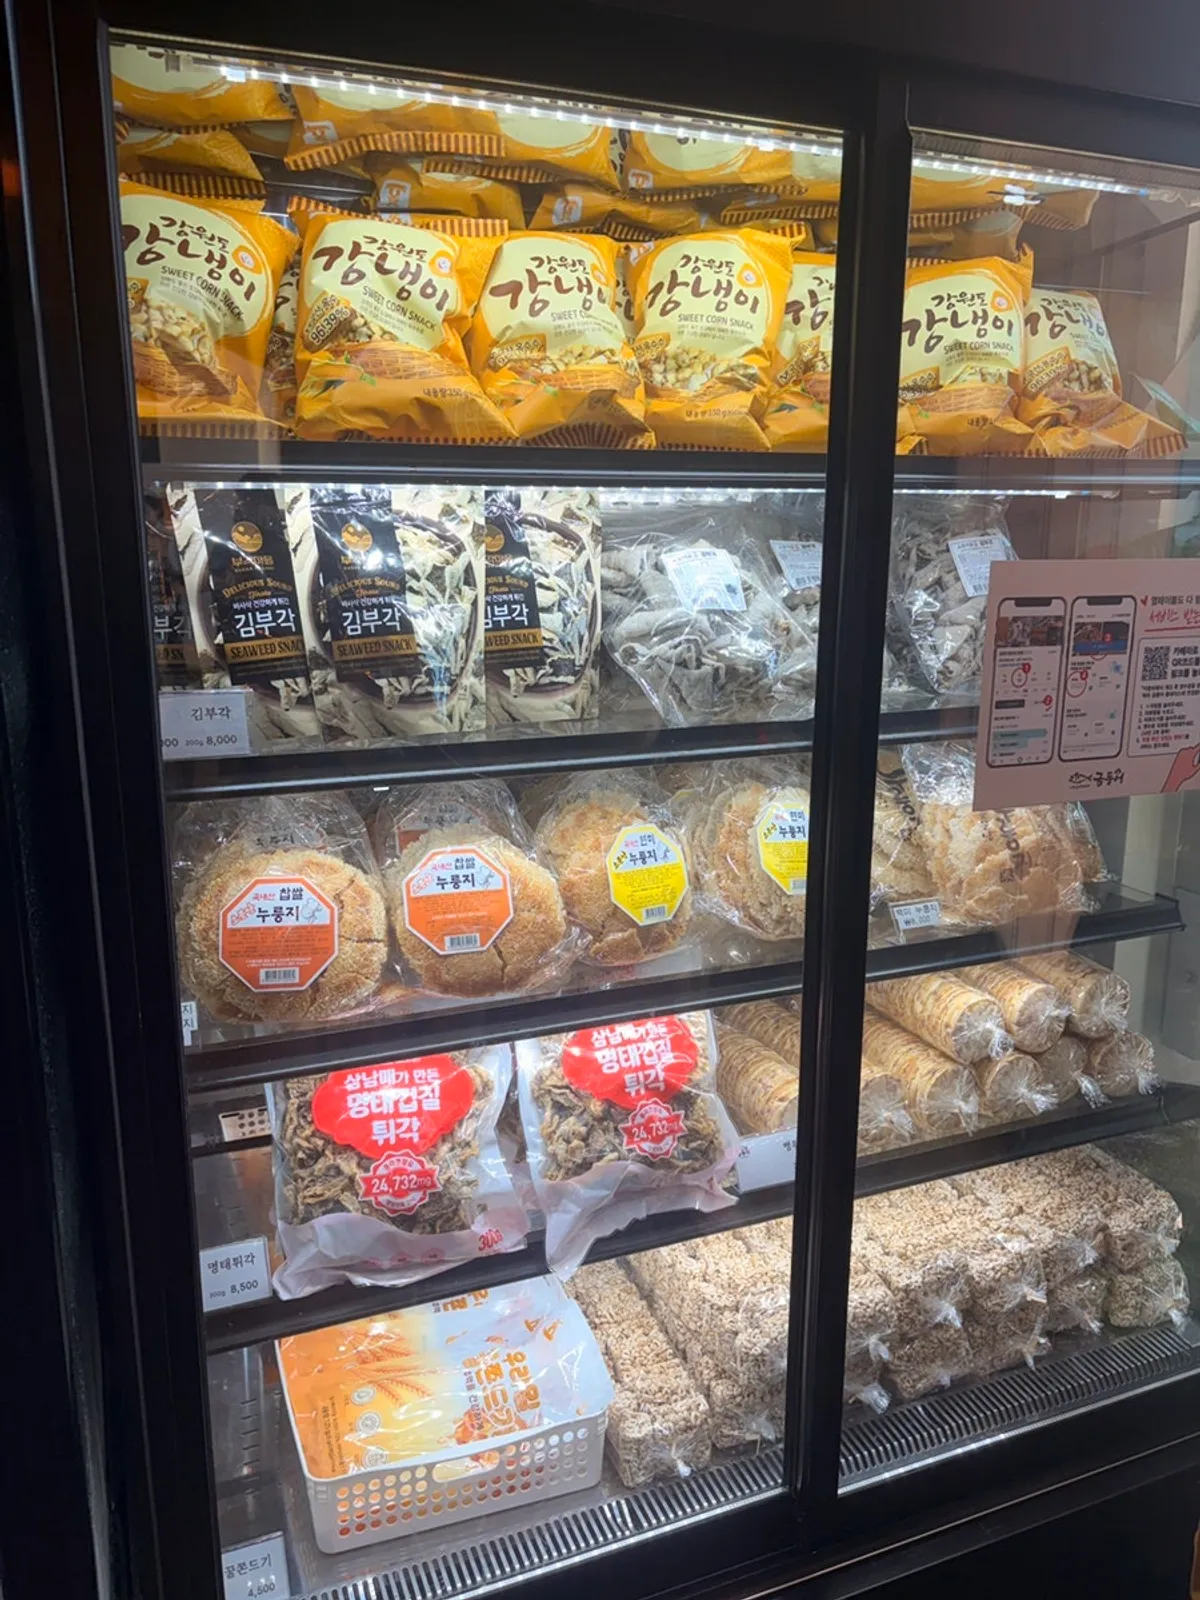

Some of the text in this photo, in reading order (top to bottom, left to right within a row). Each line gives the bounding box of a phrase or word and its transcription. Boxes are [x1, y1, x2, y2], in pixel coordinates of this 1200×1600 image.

[679, 254, 735, 277] 강원도
[160, 265, 195, 282] SWEET
[195, 275, 220, 298] CORN
[312, 239, 450, 312] 강냉이
[645, 269, 760, 318] 강냉이
[931, 291, 988, 310] 강원도
[362, 285, 386, 307] SWEET
[386, 299, 408, 318] CORN
[408, 310, 437, 332] SNACK
[550, 309, 578, 322] SWEET
[677, 313, 755, 331] SWEET CORN SNACK
[900, 308, 1014, 353] 강냉이
[1024, 303, 1105, 340] 강냉
[943, 341, 1015, 355] SWEET CORN SNACK
[153, 613, 194, 641] 부각
[234, 608, 296, 638] 김부각
[342, 607, 403, 636] 김부각
[230, 645, 277, 660] SEAWEED
[336, 644, 384, 658] SEAWEED
[191, 706, 231, 722] 김부각
[205, 734, 238, 748] 8,000
[778, 824, 807, 839] 누룽지
[454, 856, 476, 871] 찹쌀
[629, 848, 659, 866] 누룽지
[436, 873, 476, 891] 누룽지
[279, 887, 304, 901] 찹쌀
[256, 905, 300, 924] 누룽지
[412, 1067, 441, 1084] 만든
[624, 1064, 666, 1098] 튀각
[371, 1117, 421, 1146] 튀각
[207, 1251, 256, 1275] 명태튀각
[230, 1279, 259, 1295] 8,500
[247, 1582, 276, 1599] 4,500
